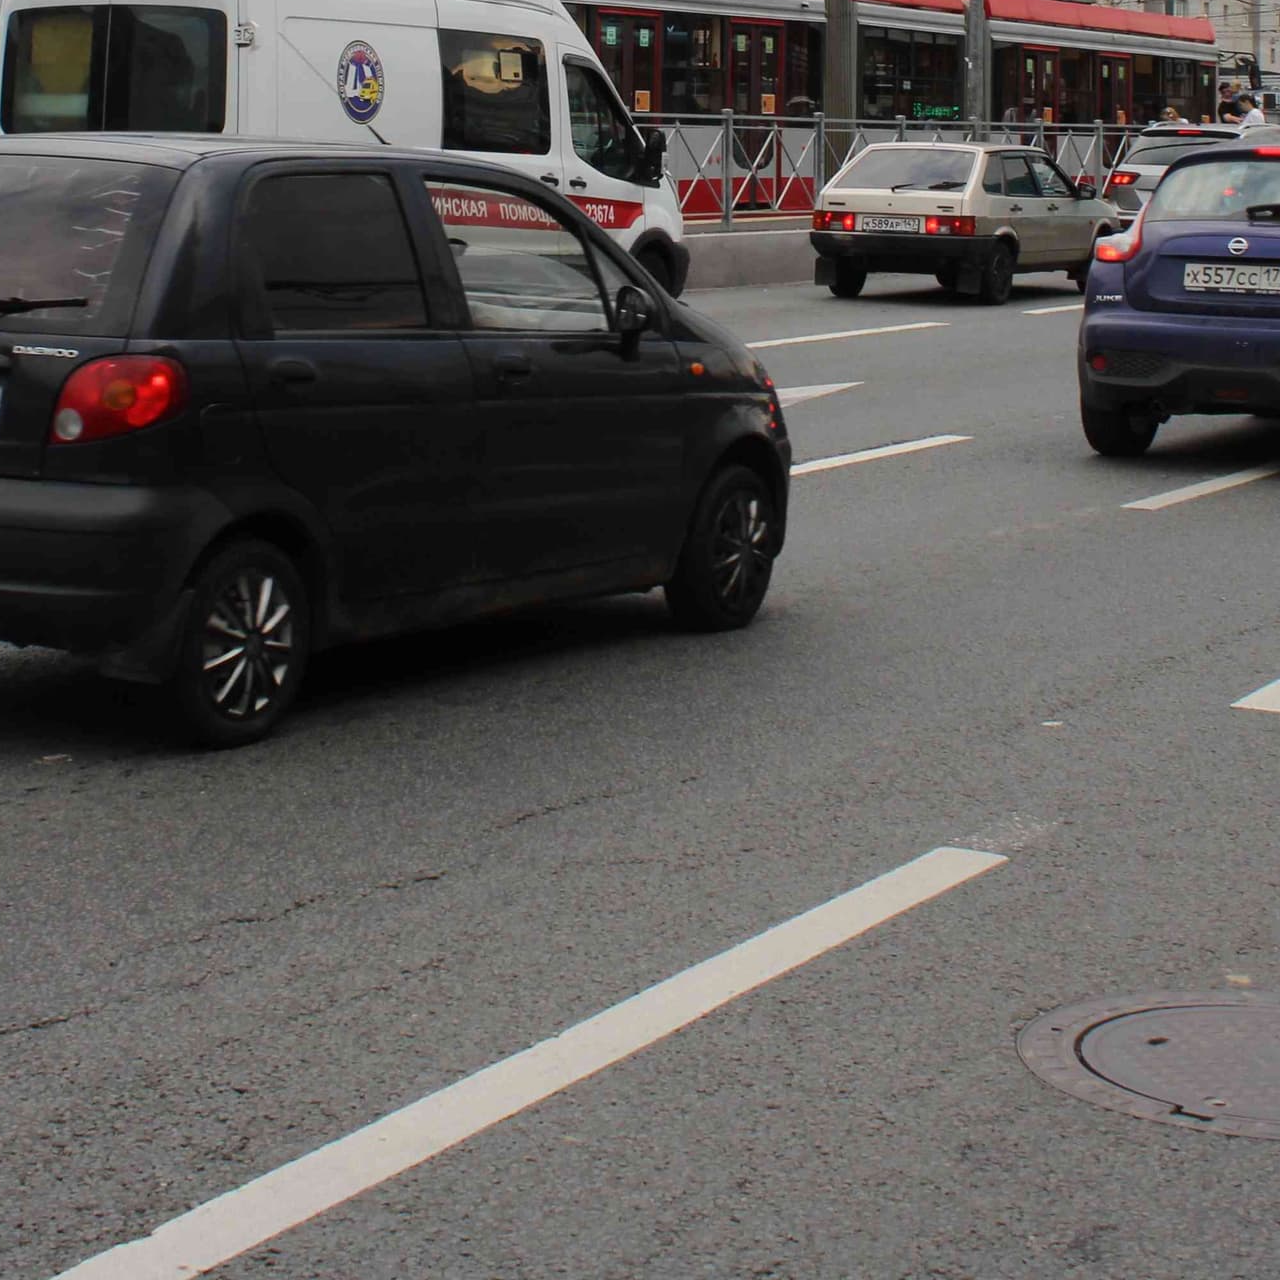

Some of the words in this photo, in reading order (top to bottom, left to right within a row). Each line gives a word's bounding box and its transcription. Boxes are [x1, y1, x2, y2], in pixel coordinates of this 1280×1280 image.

[432, 197, 488, 218] ИНСКАЯ
[585, 203, 615, 223] 23674
[1191, 267, 1258, 286] Х557СС
[13, 346, 79, 358] DAEWOO
